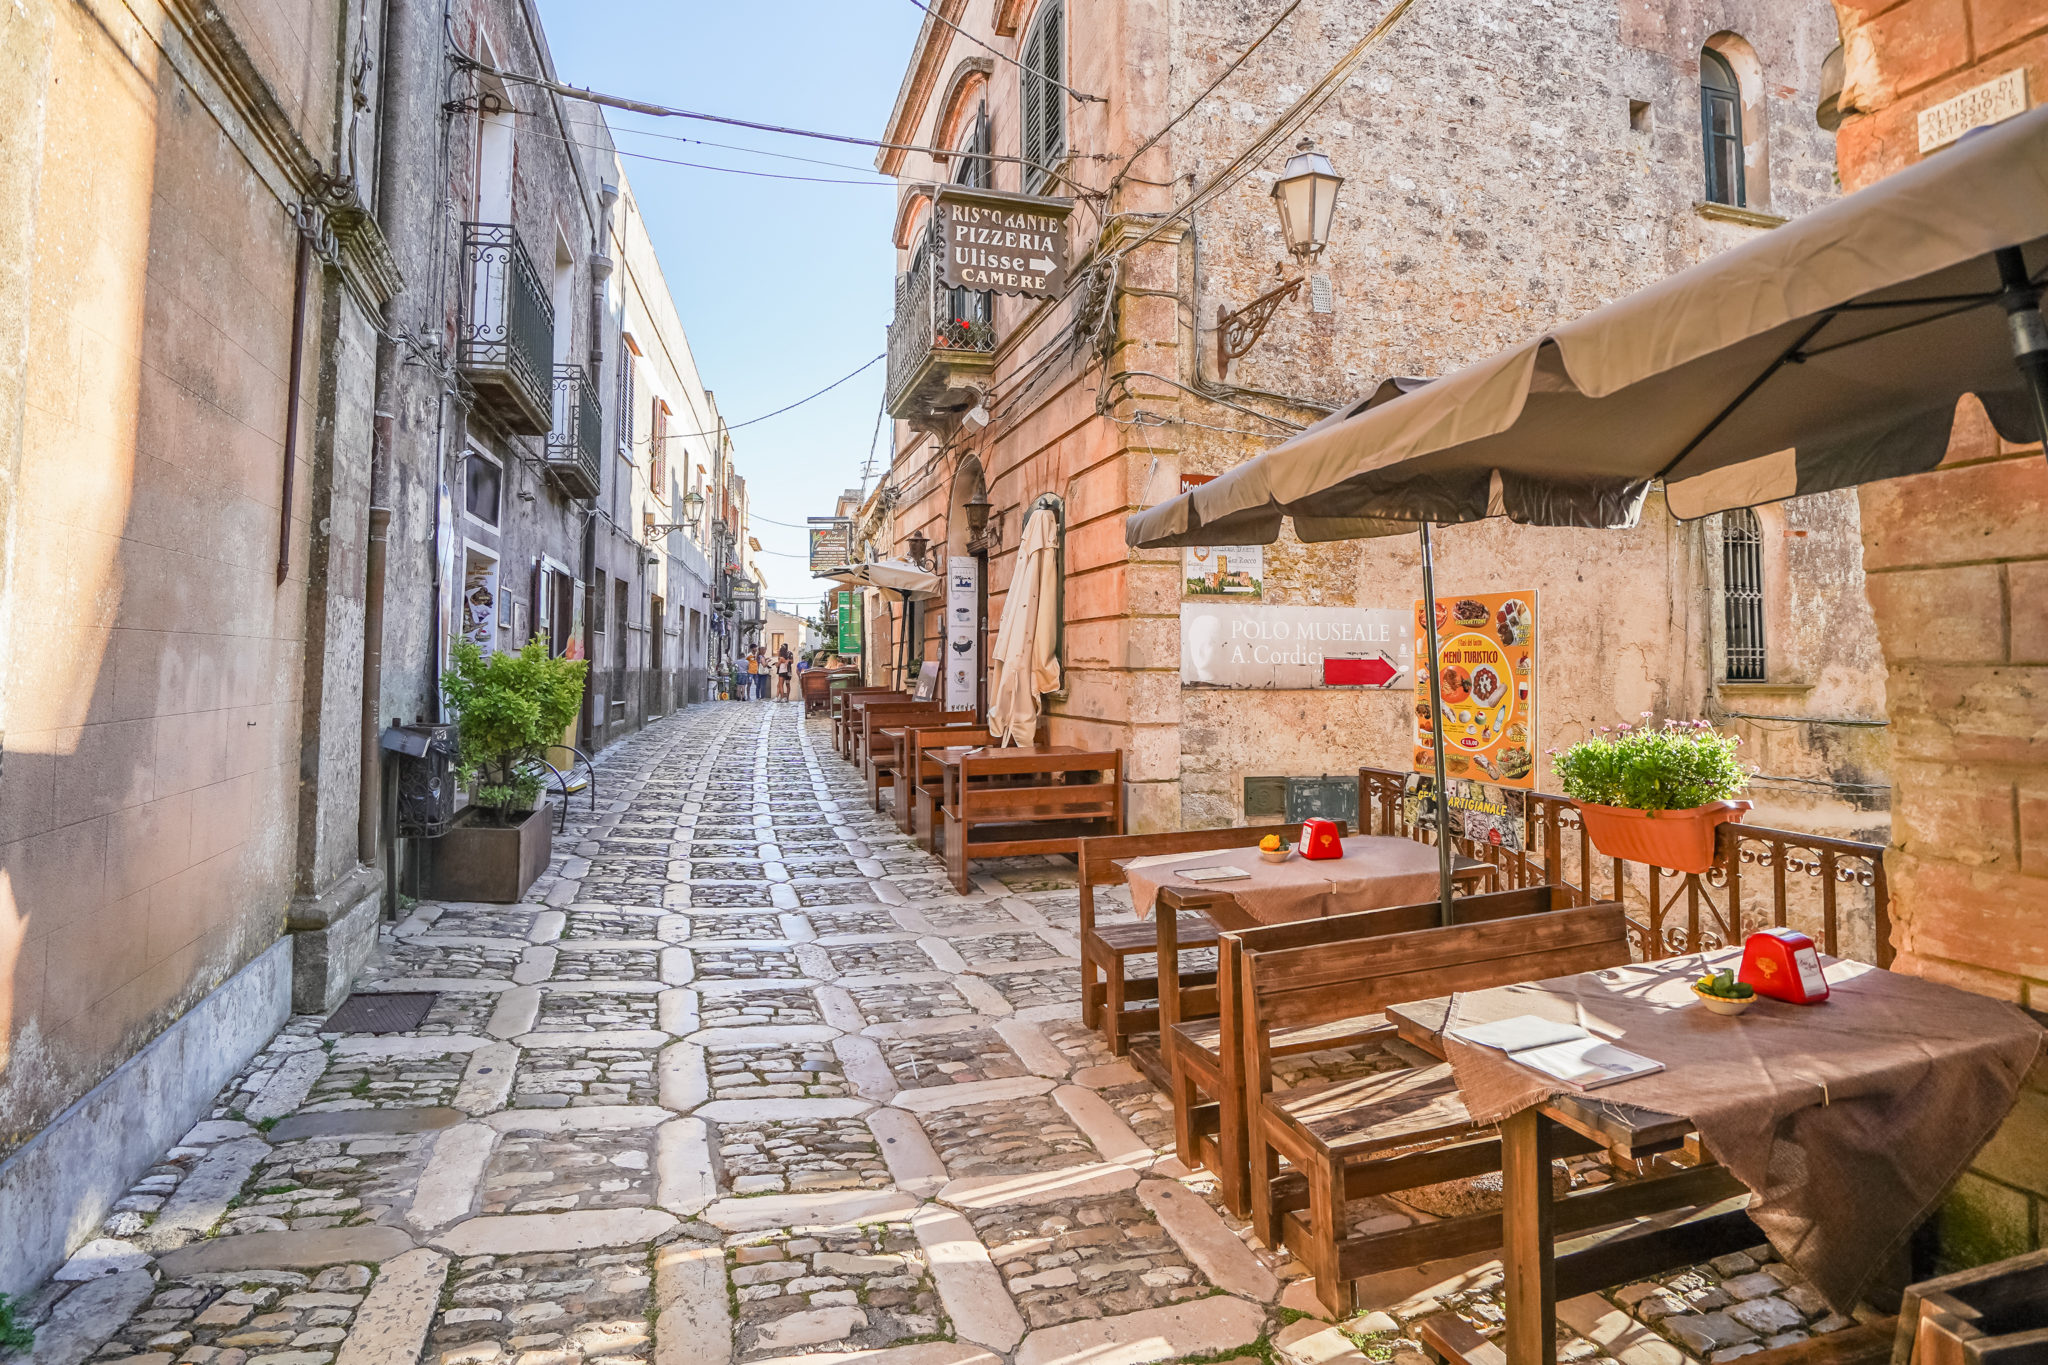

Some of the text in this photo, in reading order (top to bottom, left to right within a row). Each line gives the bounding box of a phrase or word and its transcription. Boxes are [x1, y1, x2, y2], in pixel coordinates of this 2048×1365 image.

[1998, 77, 2014, 92] DI
[955, 226, 1054, 253] PIZZERIA
[955, 247, 1025, 271] Ulisse
[961, 269, 1046, 290] CAMERE
[1231, 620, 1391, 642] POLO MUSEALE
[1231, 643, 1324, 665] A. Cordici
[1443, 649, 1499, 664] MENÙ TURISTICO
[1448, 796, 1508, 817] ARTIGIANALE
